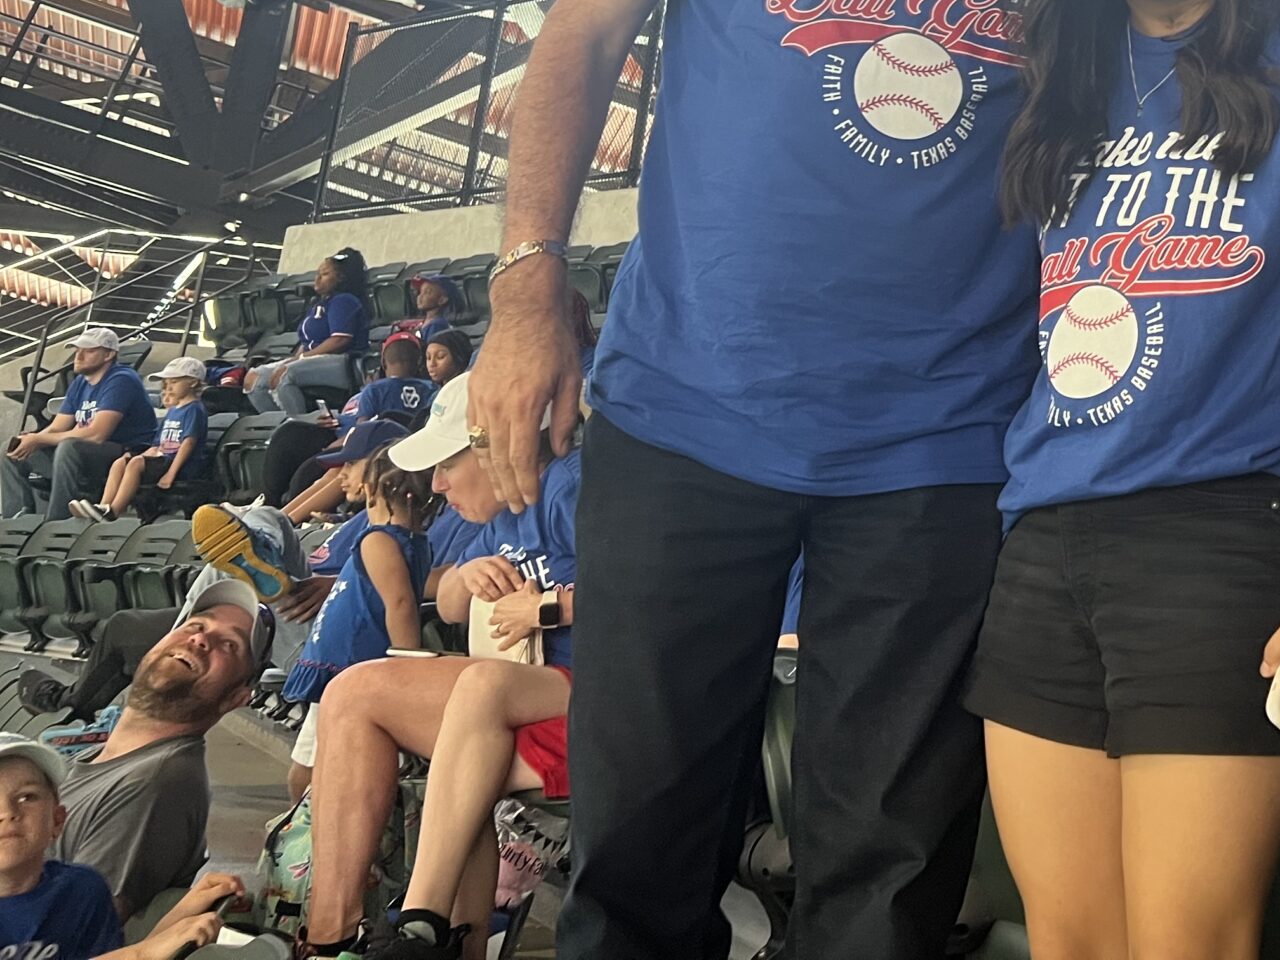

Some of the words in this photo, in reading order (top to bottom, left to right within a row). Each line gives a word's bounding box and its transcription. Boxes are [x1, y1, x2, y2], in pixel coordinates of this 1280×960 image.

[823, 54, 845, 103] FAITH
[835, 119, 891, 167] FAMILY
[910, 137, 957, 170] TEXAS
[1095, 171, 1152, 228] TO
[1164, 166, 1254, 233] THE
[1041, 236, 1089, 288] all
[1089, 214, 1251, 293] Game
[1087, 388, 1134, 428] TEXAS
[1131, 301, 1165, 392] BASEBALL
